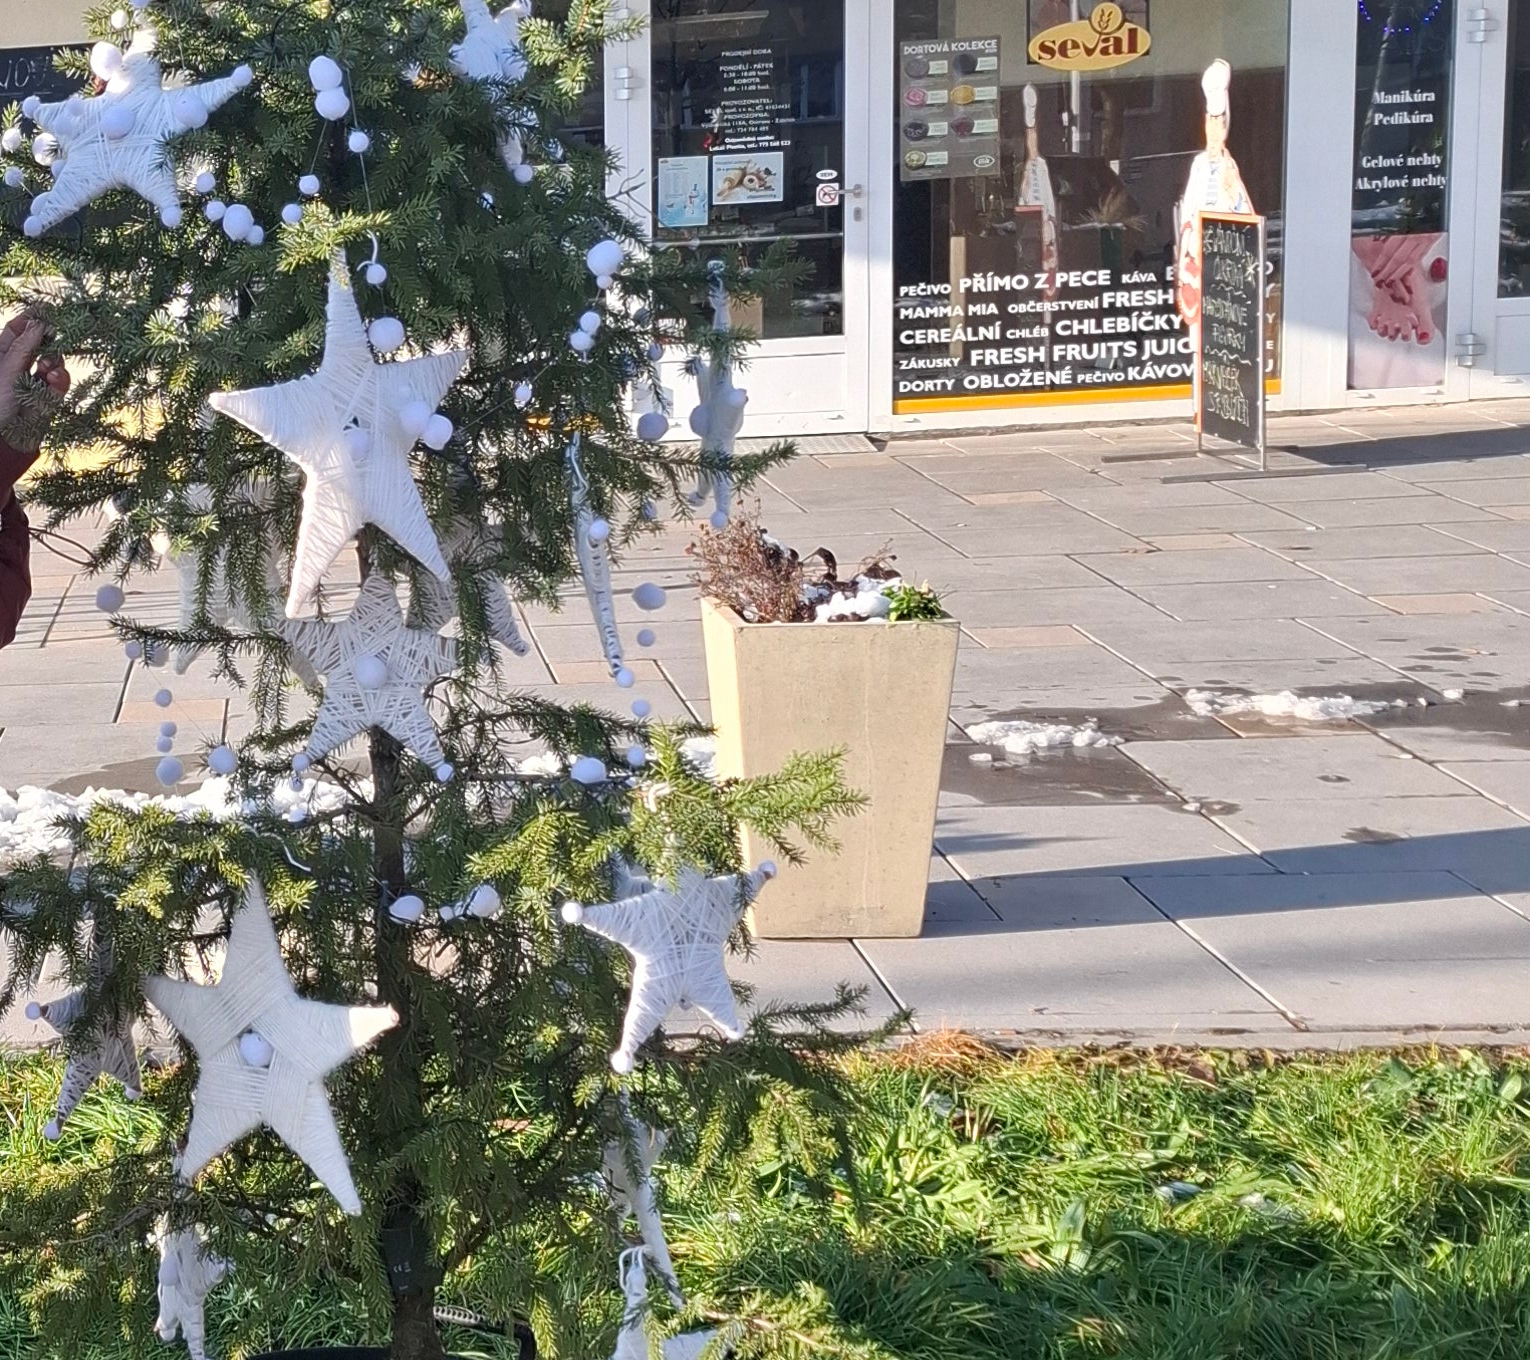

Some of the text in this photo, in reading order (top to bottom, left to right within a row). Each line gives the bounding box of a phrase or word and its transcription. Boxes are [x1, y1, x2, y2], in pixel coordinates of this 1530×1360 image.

[903, 39, 998, 55] DORTOVÁ KOLEKCE
[1037, 27, 1140, 61] seval
[1373, 88, 1436, 105] Manikúra
[1373, 110, 1434, 126] Pedikúra
[1362, 152, 1444, 169] Gelové nehty
[1354, 172, 1449, 193] Akrylové nehty
[899, 282, 952, 297] PEČIVO
[959, 271, 1029, 294] PŘÍMO
[1034, 273, 1050, 289] Z
[1055, 269, 1111, 289] PECE
[1121, 270, 1157, 284] KÁVA
[899, 288, 1175, 320] MAMMA MIA OBČERSTVENÍ FRESH
[899, 311, 1184, 345] CEREÁLNÍ CHLÉB CHLEBÍČKY
[899, 337, 1196, 370] ZÁKUSKY FRESH FRUITS JUIC
[899, 362, 1195, 393] DORTY OBLOŽENÉ PEČIVO KÁVOV
